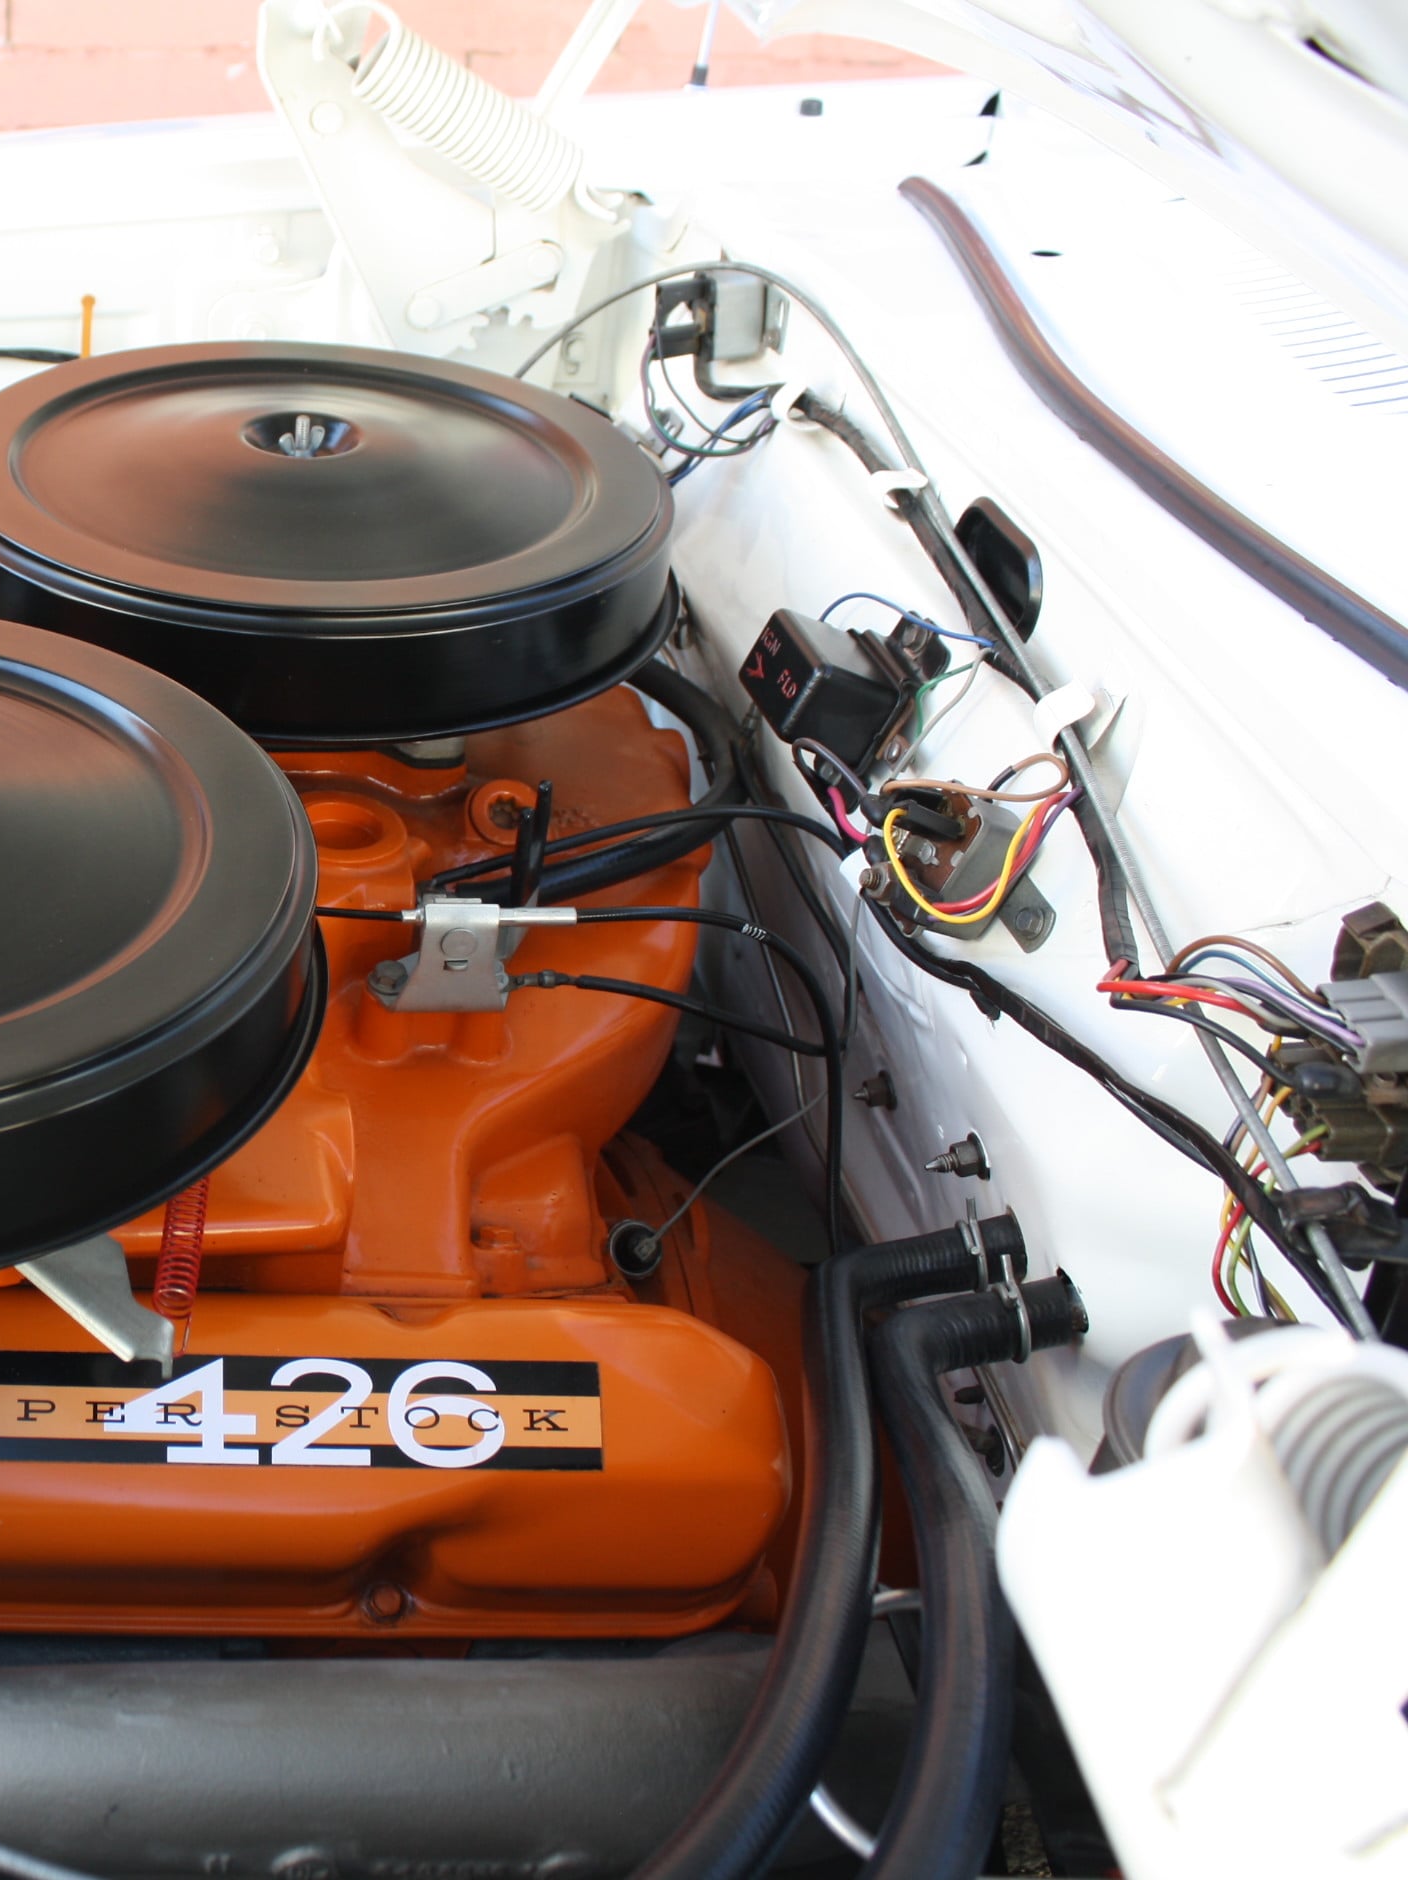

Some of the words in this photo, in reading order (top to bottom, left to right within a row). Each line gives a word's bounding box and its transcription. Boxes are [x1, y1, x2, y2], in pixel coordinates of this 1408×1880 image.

[761, 627, 782, 656] IGN
[103, 1357, 506, 1468] 426
[275, 1404, 569, 1432] STOCK
